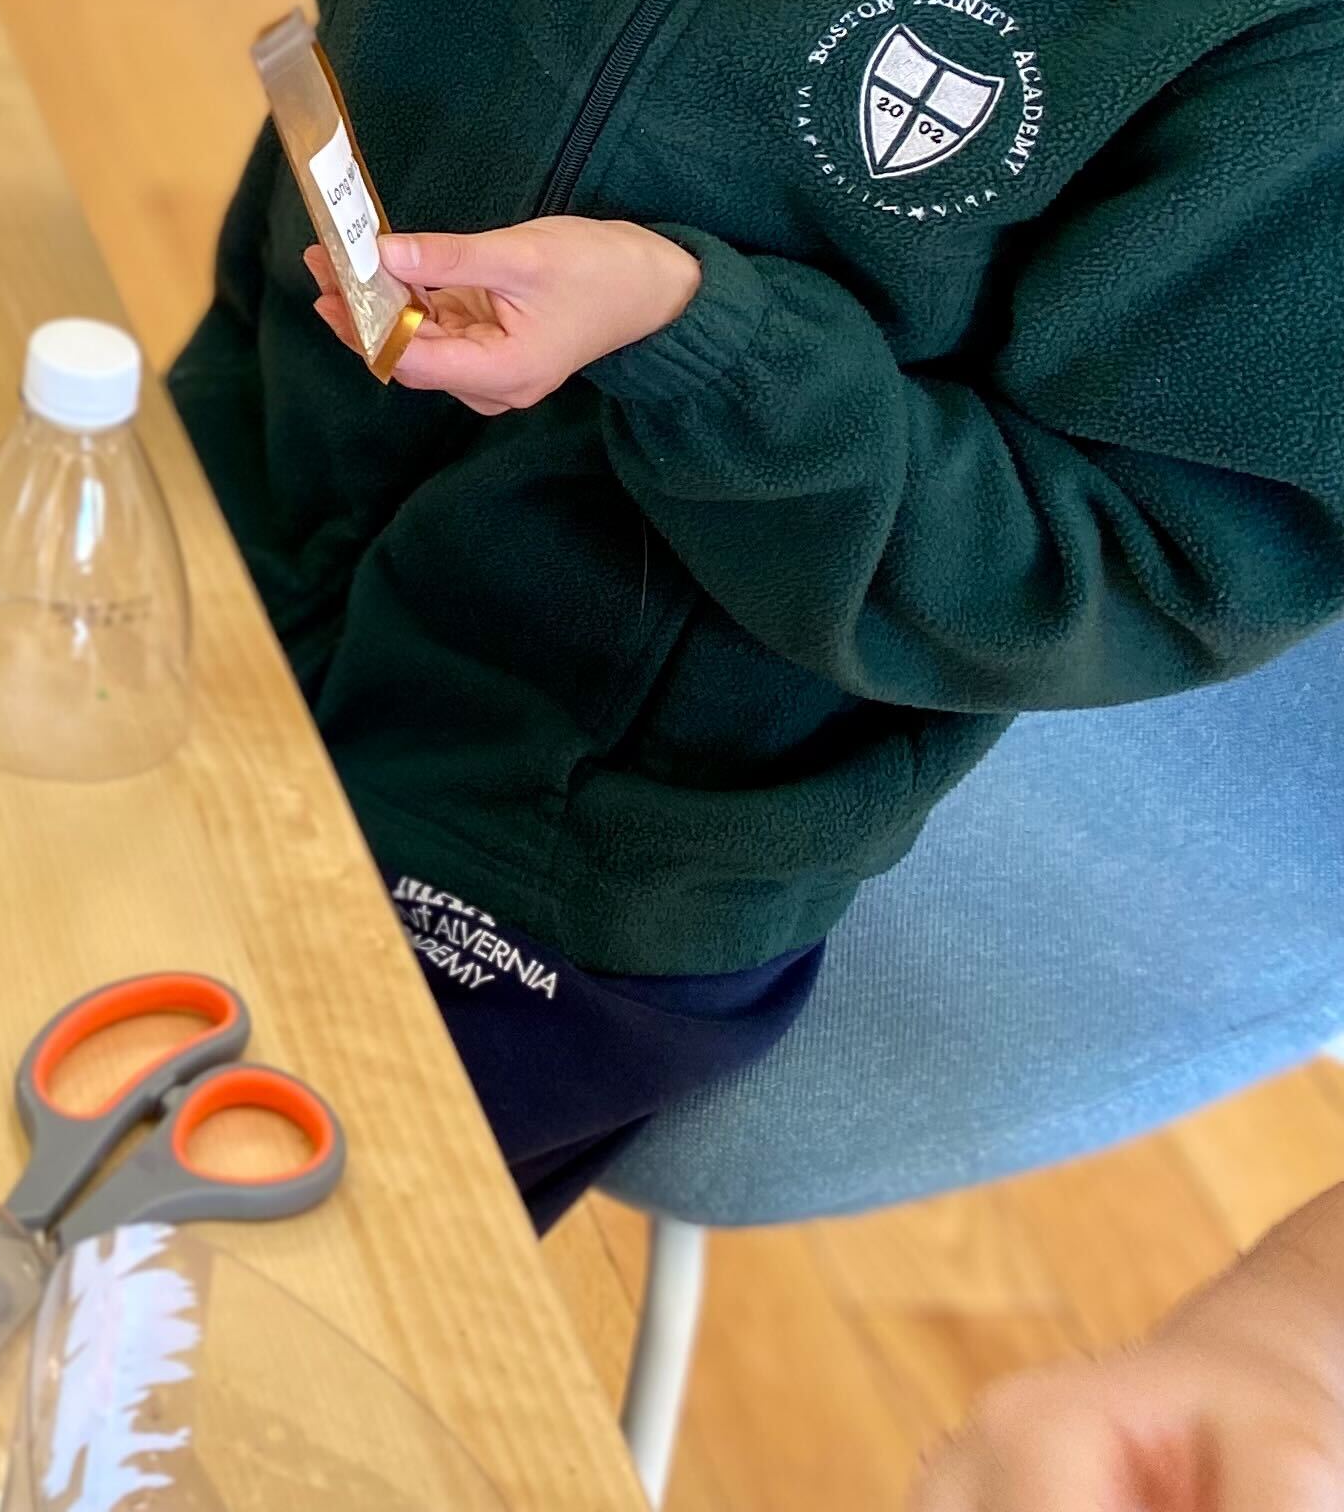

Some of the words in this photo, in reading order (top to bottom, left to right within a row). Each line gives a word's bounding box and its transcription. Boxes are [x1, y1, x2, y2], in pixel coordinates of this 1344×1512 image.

[876, 96, 905, 118] 20
[1004, 49, 1045, 176] ACADEMY
[918, 120, 945, 144] 02
[326, 178, 352, 206] Long
[410, 933, 495, 989] DEMY
[434, 914, 558, 999] ALVERNIA
